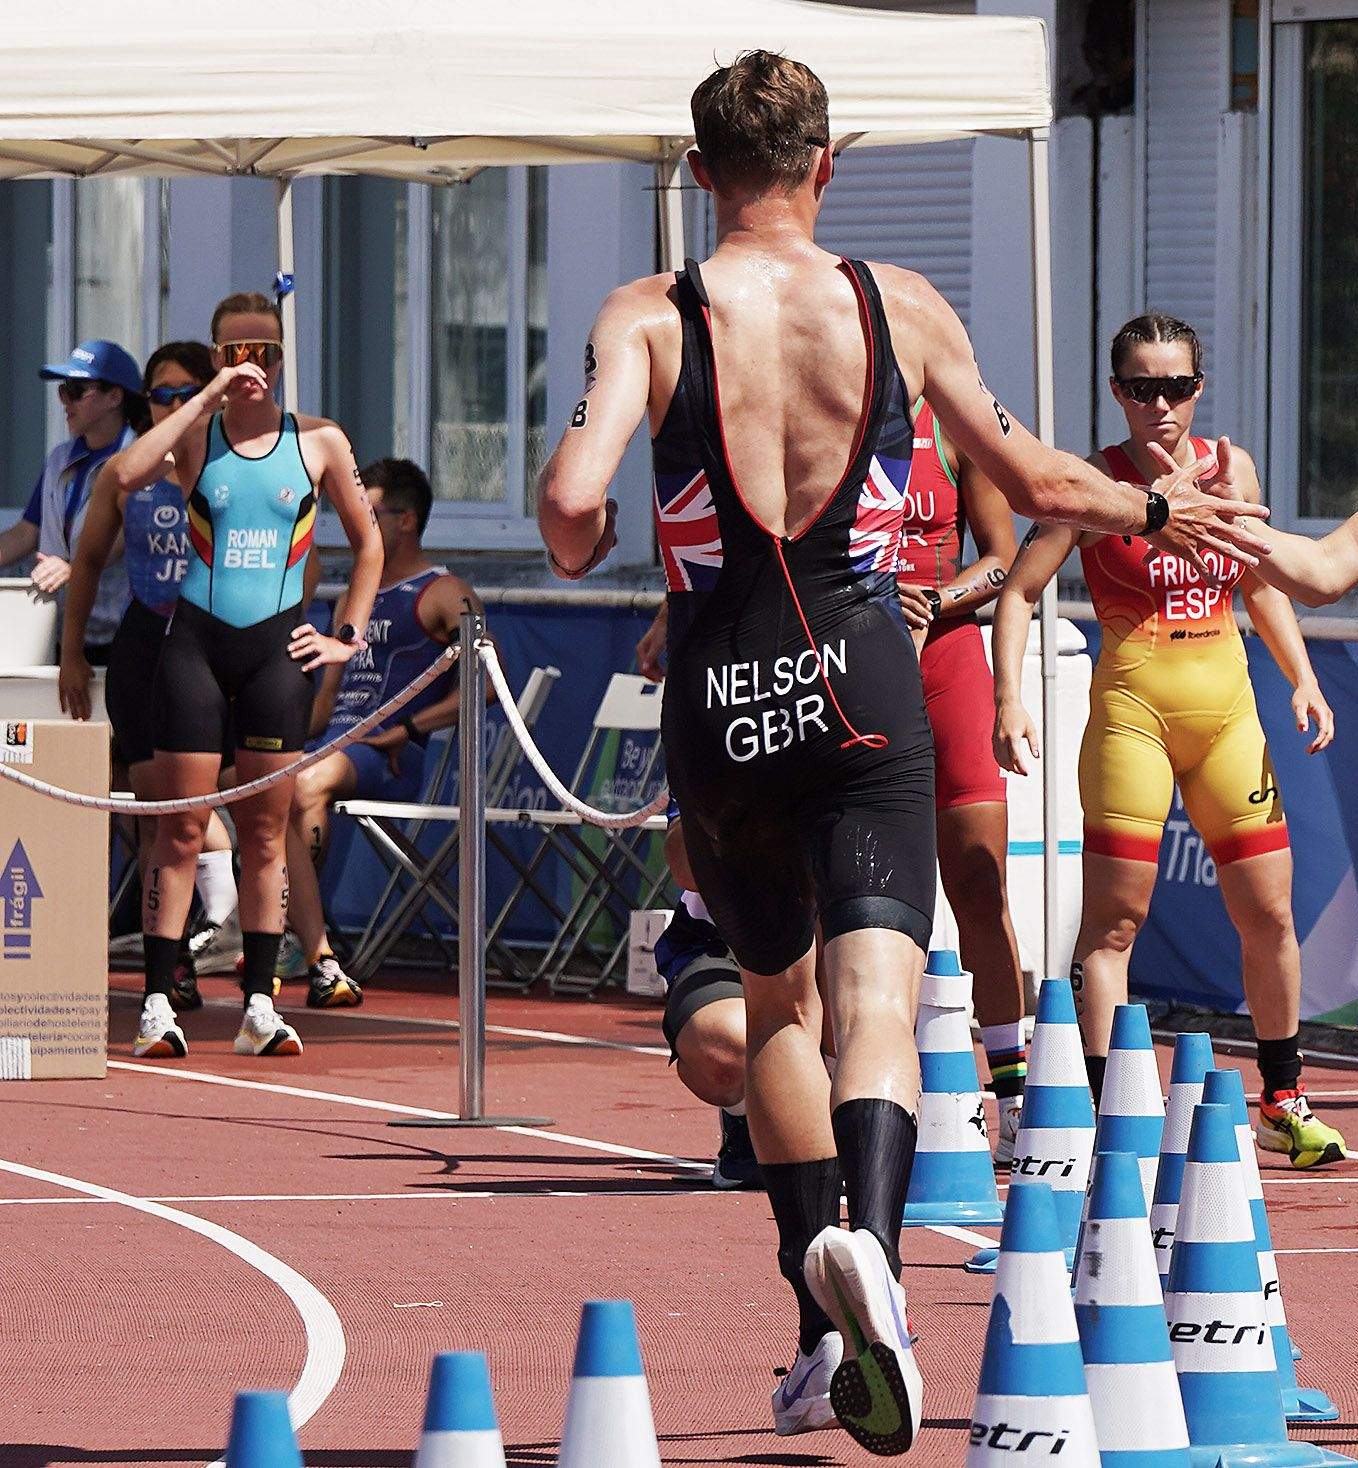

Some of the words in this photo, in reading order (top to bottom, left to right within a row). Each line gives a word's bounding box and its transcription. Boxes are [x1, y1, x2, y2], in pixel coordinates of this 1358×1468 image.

[572, 399, 588, 428] B
[227, 529, 278, 549] ROMAN
[223, 548, 277, 569] BEL
[1166, 587, 1220, 620] ESP
[706, 639, 848, 709] NELSON
[725, 694, 829, 762] GBR
